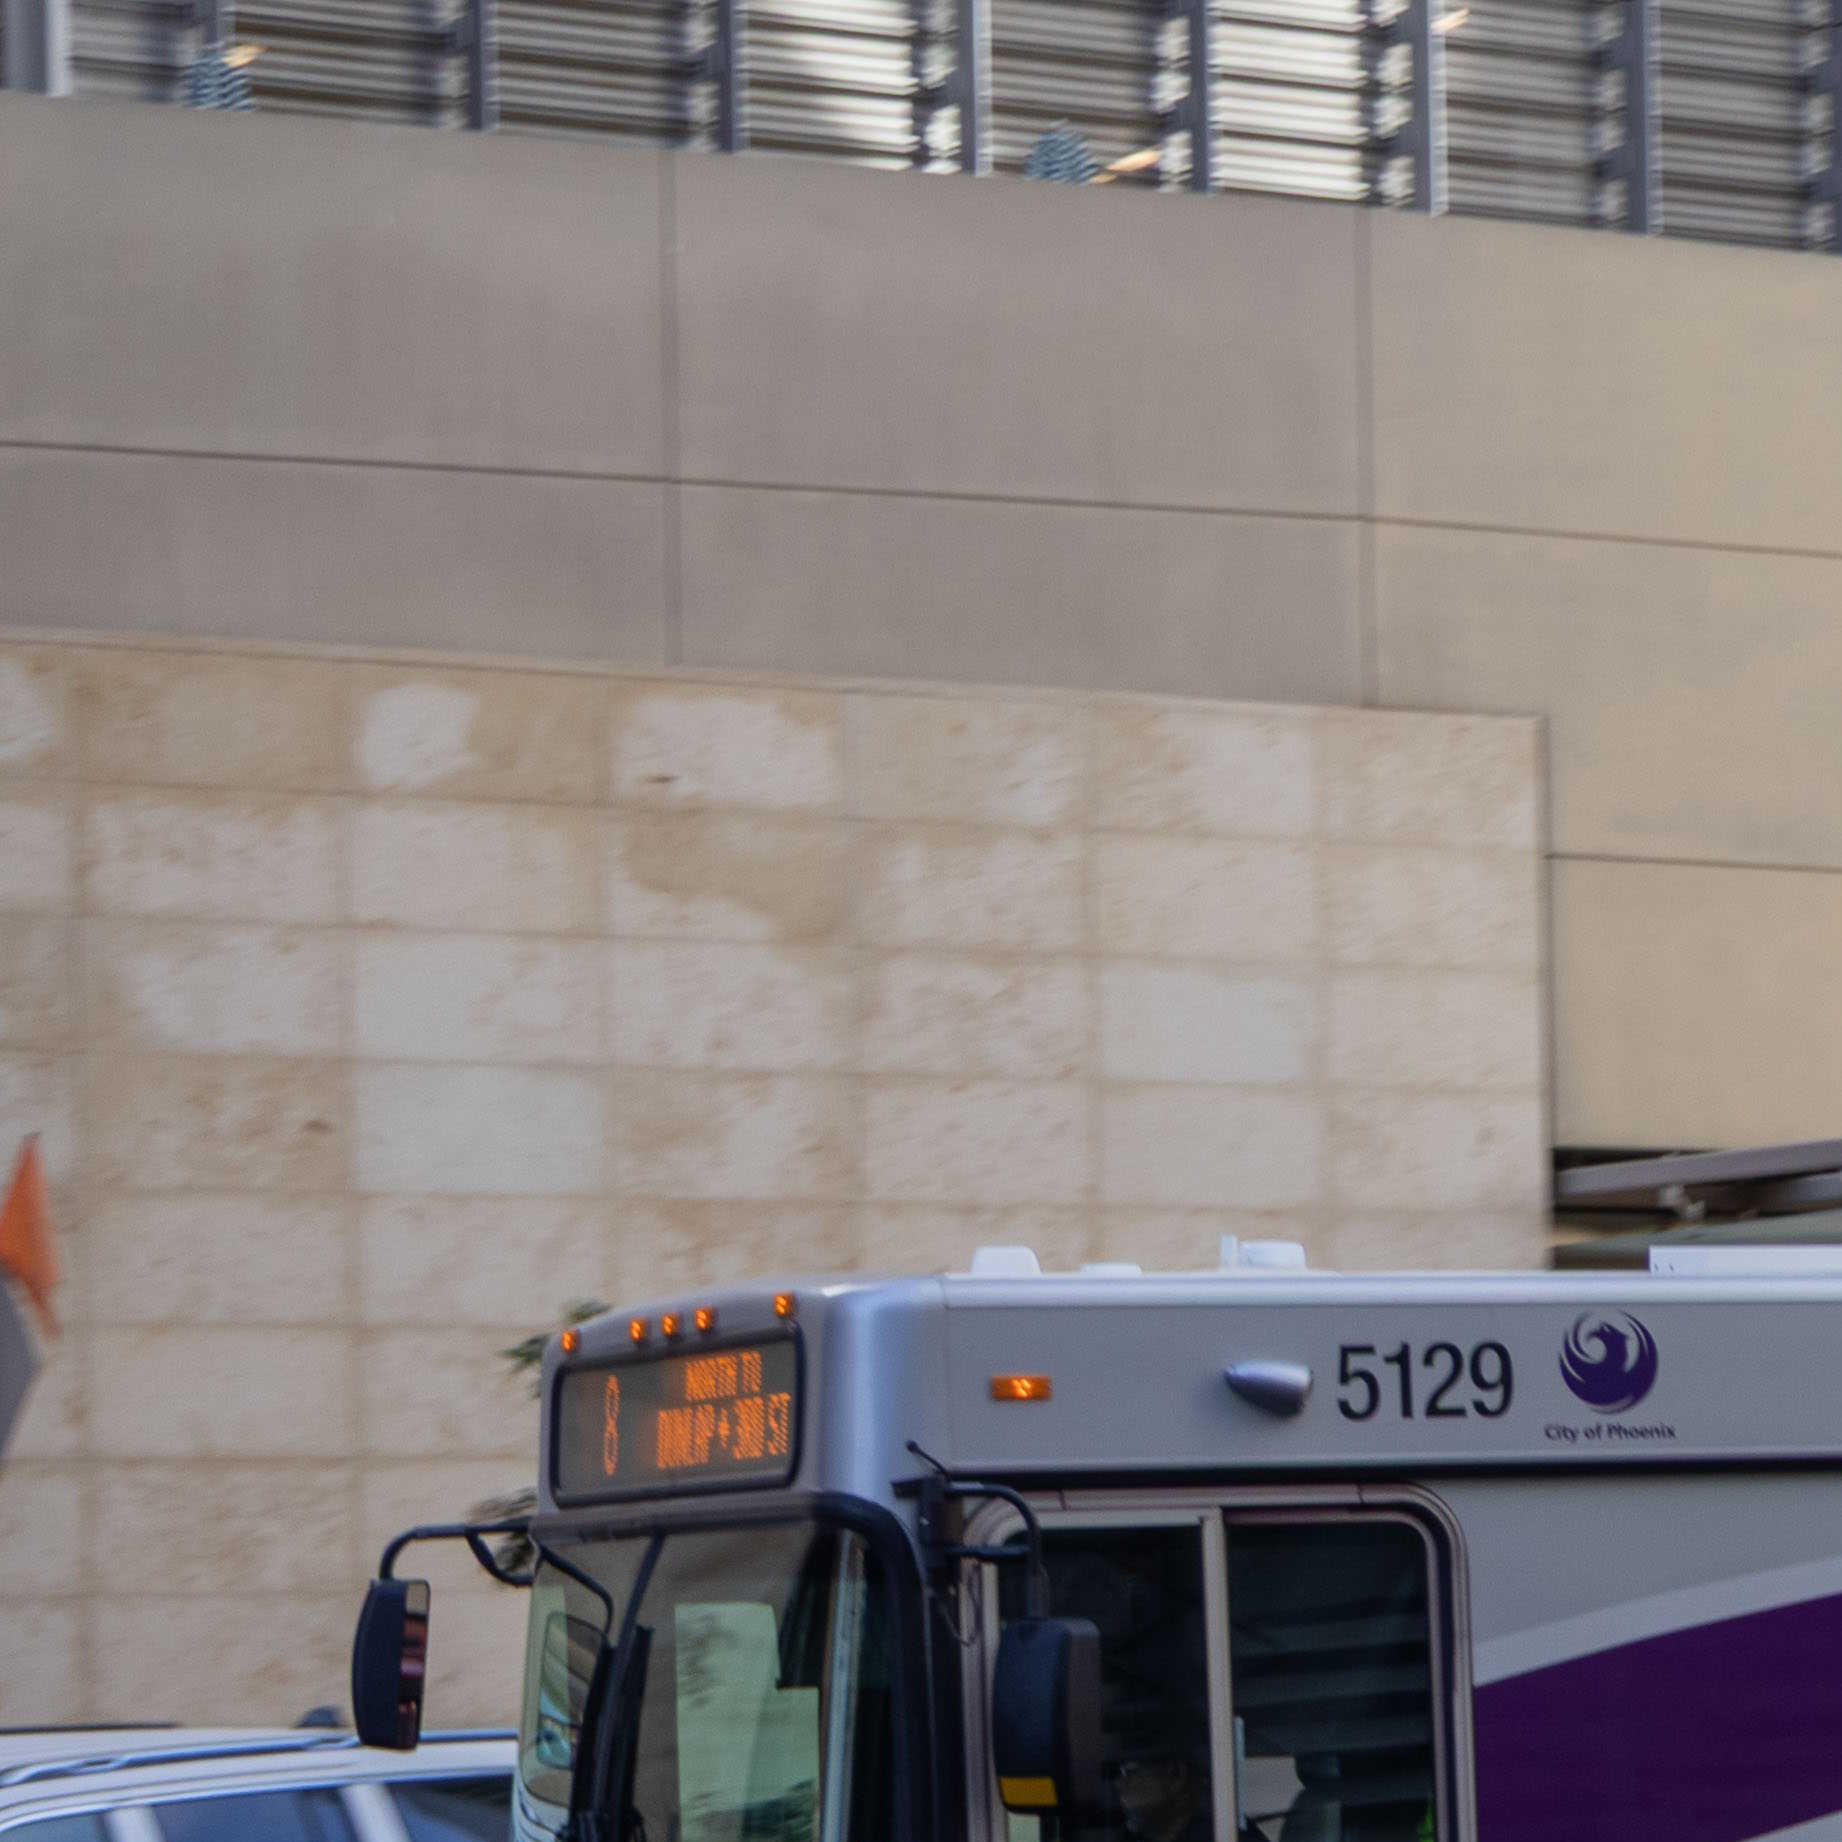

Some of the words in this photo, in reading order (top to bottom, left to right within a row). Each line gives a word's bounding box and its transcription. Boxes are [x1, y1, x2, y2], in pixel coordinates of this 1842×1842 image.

[1336, 1340, 1514, 1421] 5129
[1544, 1423, 1577, 1444] City
[1583, 1422, 1602, 1440] of
[1606, 1422, 1676, 1441] Phoenix
